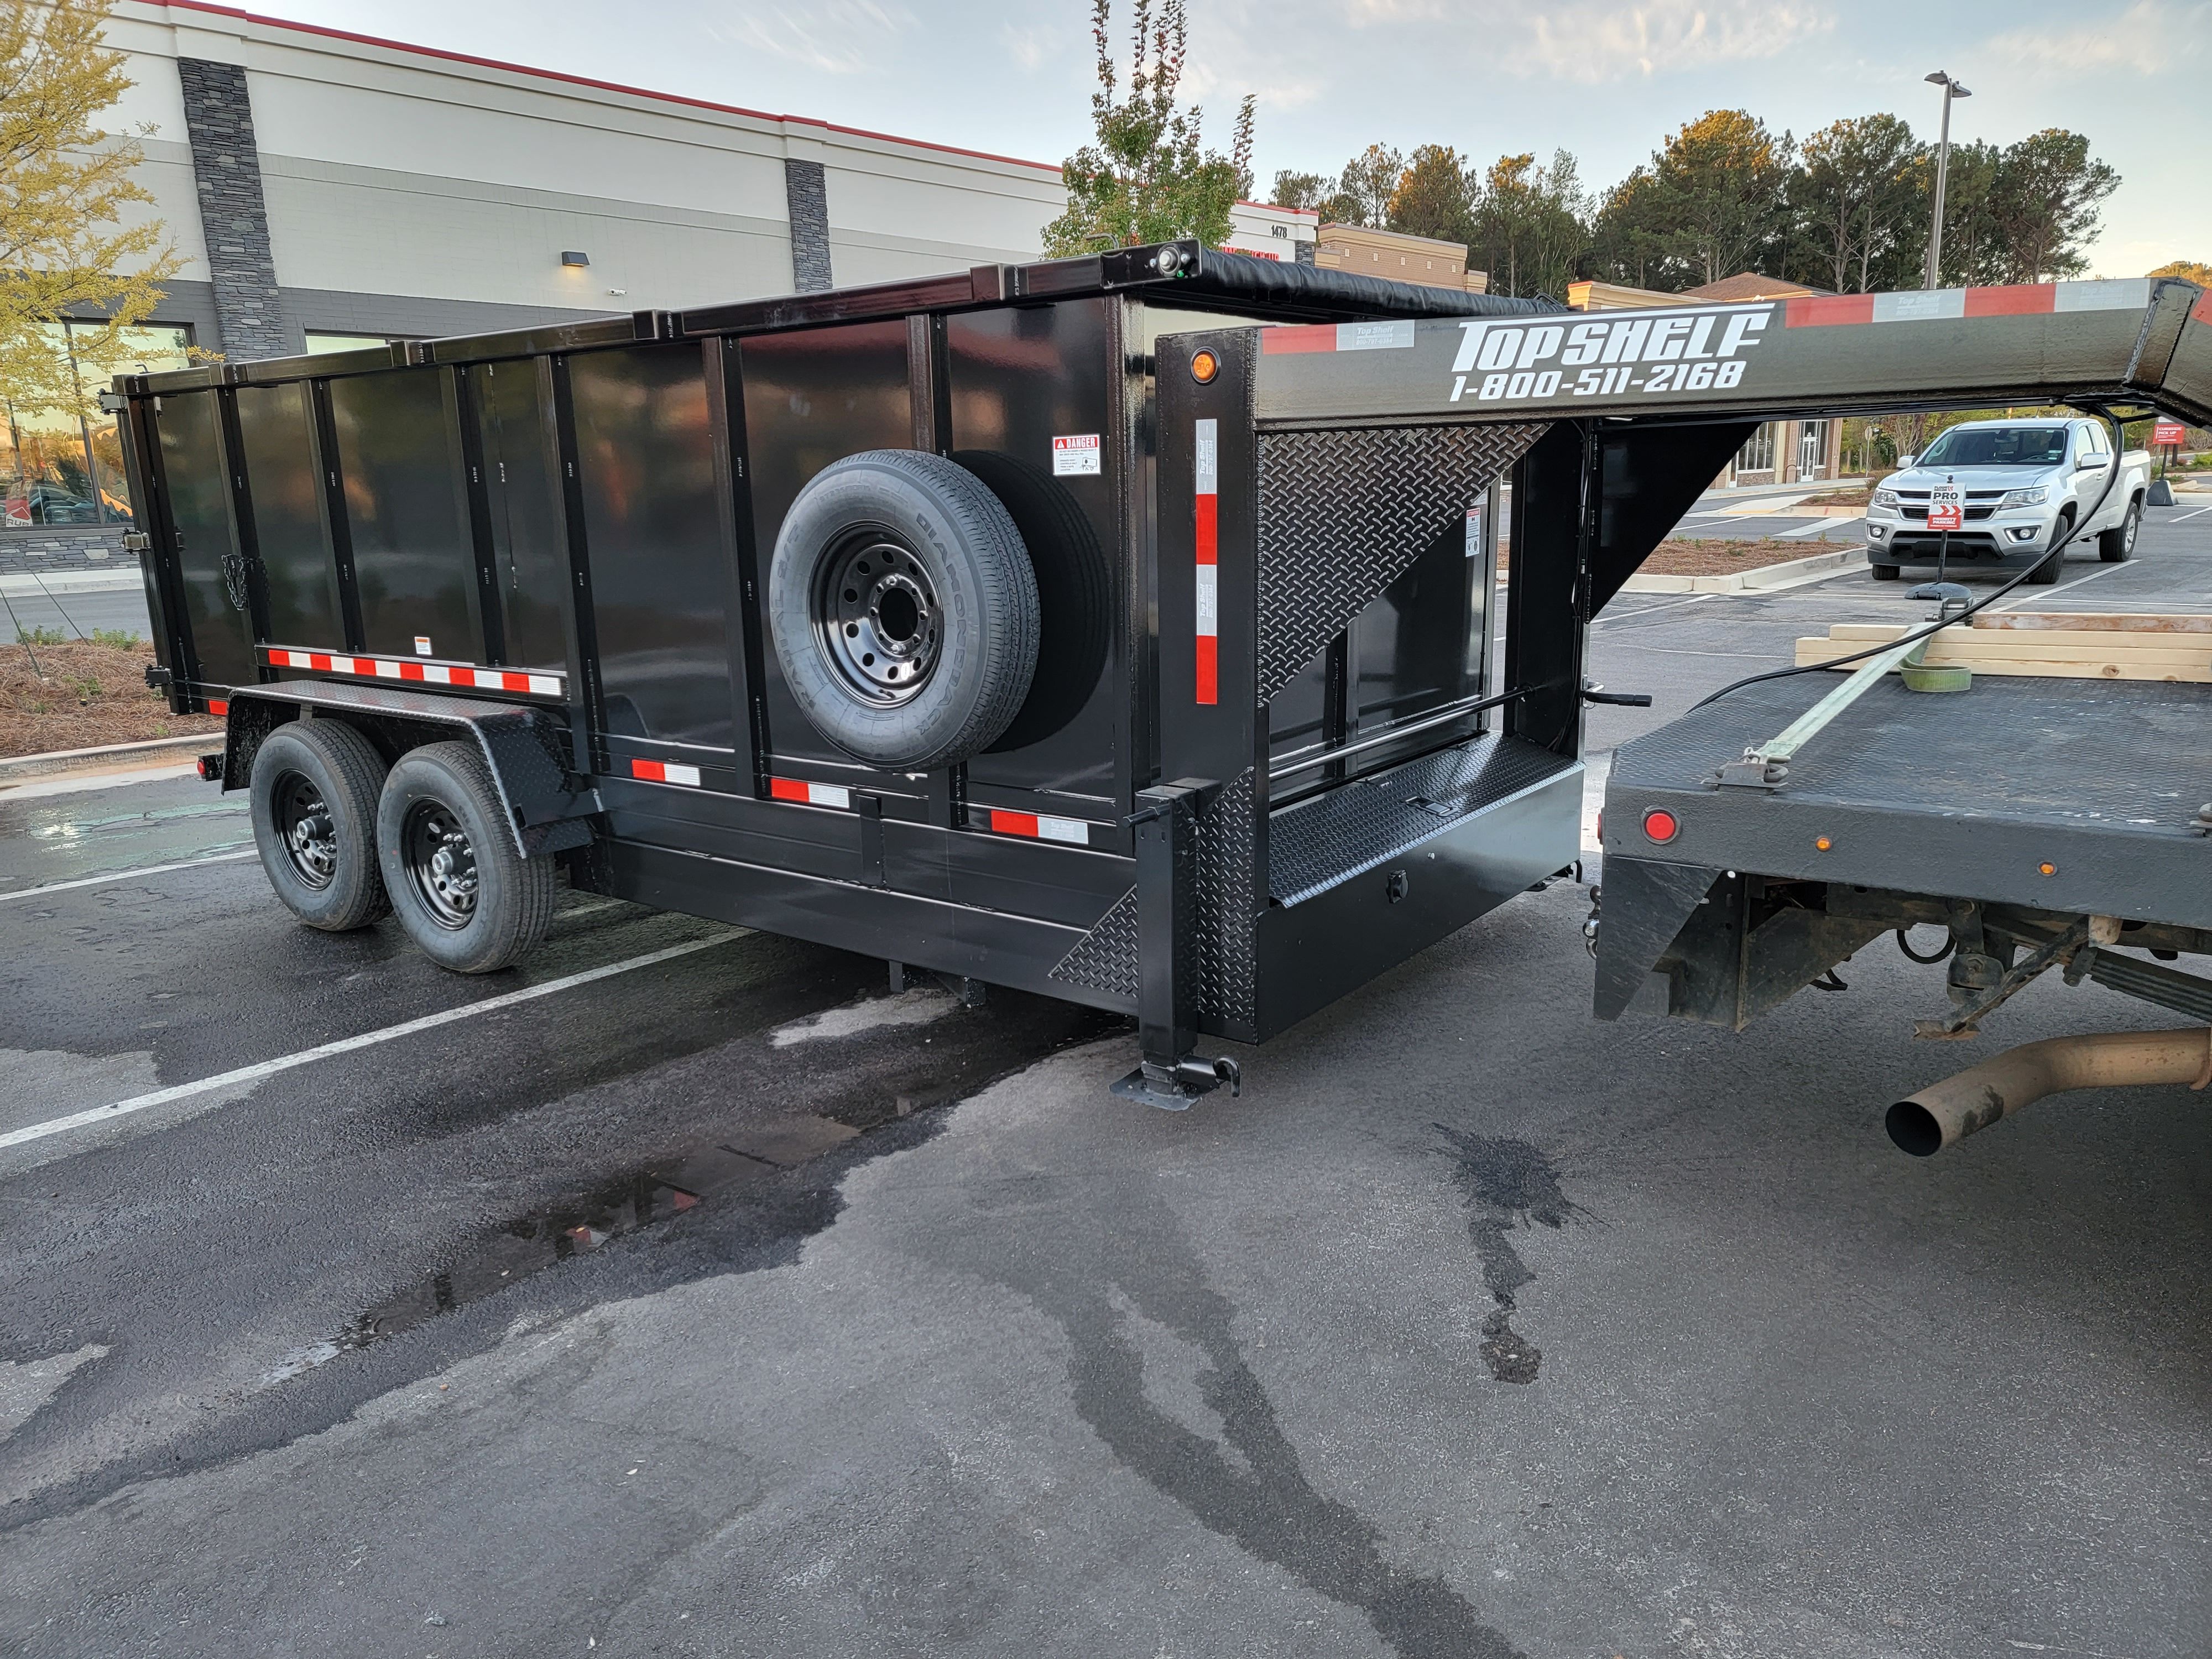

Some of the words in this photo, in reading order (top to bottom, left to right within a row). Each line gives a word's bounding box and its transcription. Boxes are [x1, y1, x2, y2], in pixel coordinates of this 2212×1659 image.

[1271, 225, 1287, 238] 1478
[1357, 327, 1371, 336] Top
[1449, 361, 1747, 402] 1-800-511-2168
[1066, 437, 1095, 448] DANGER
